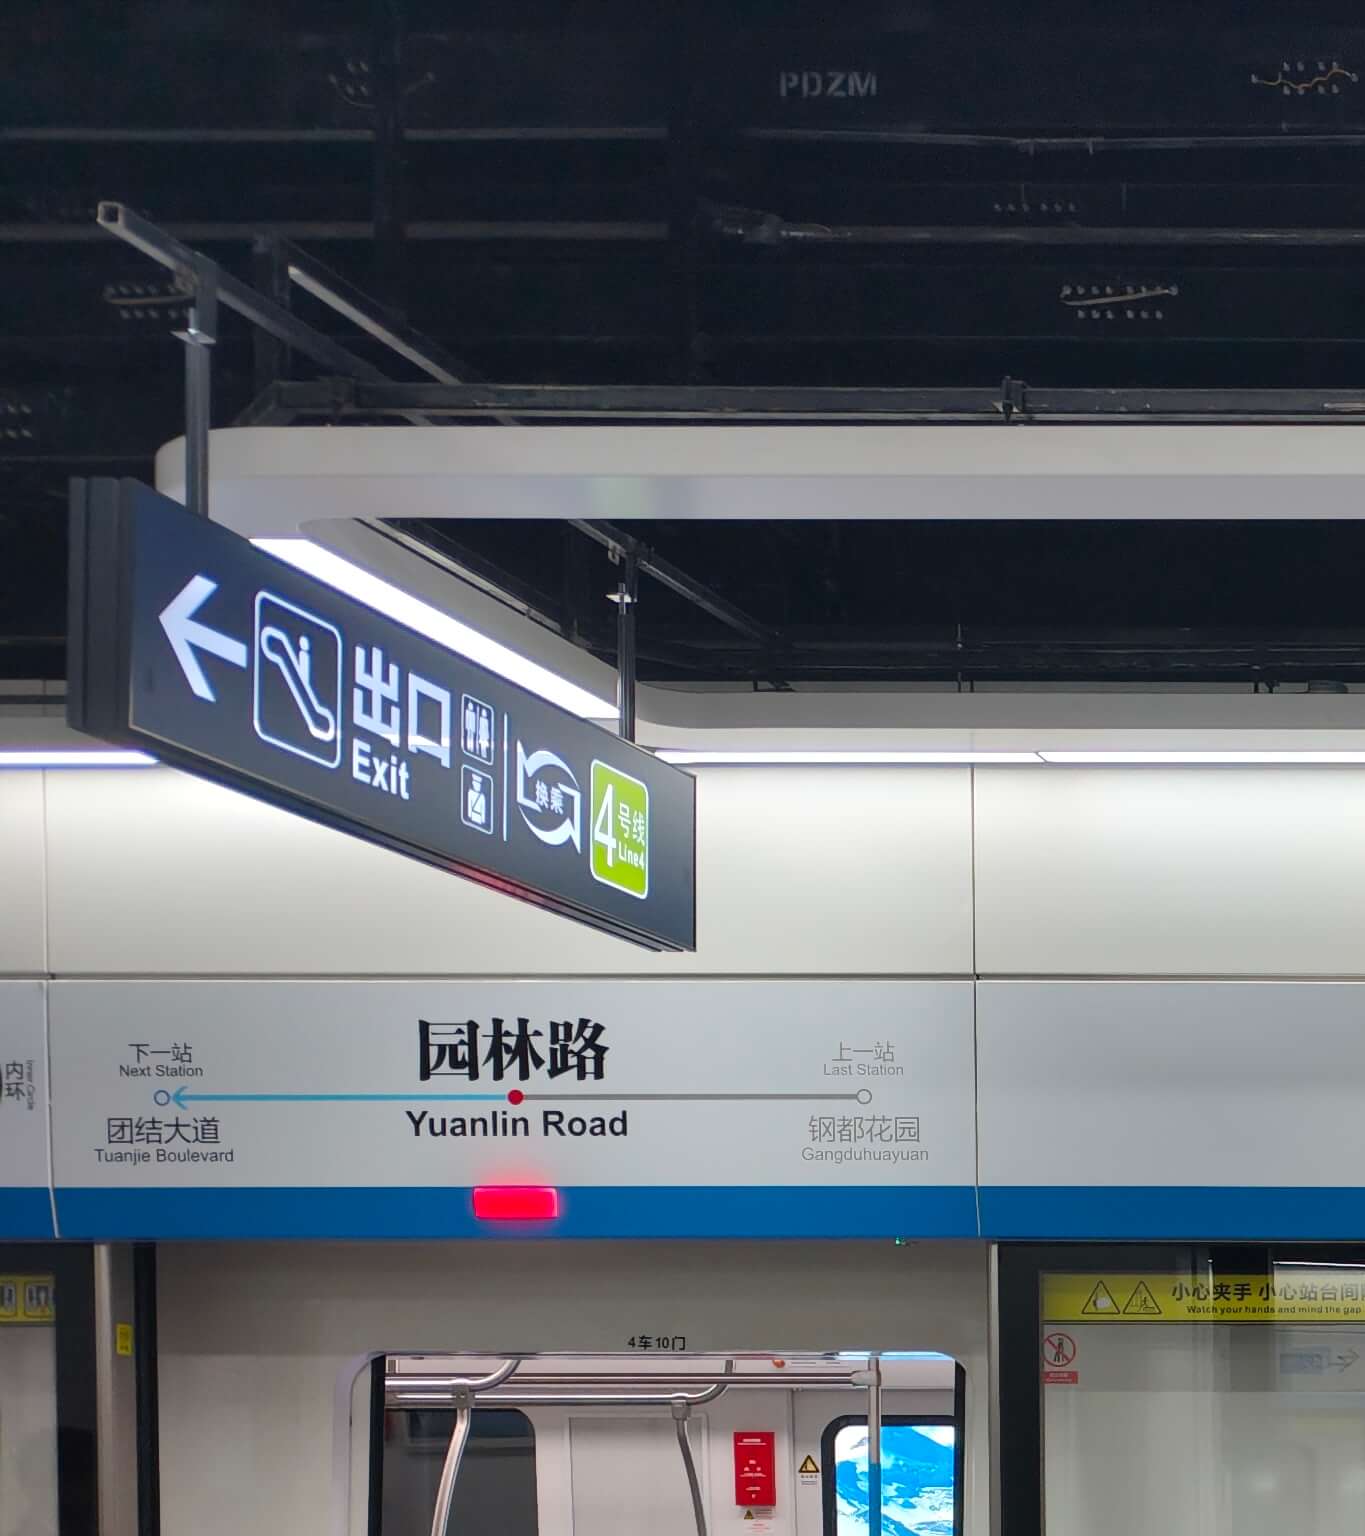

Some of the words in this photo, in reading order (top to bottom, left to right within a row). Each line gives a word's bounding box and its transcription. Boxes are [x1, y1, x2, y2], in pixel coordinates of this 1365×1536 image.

[780, 71, 877, 97] PDZM
[353, 645, 451, 768] 出口
[352, 743, 409, 800] Exit
[535, 779, 564, 815] 换乘
[128, 1043, 193, 1063] 下一站
[418, 1018, 610, 1081] 园林路
[832, 1040, 895, 1062] 上一站
[119, 1065, 151, 1077] Next
[155, 1064, 204, 1077] Station
[823, 1063, 853, 1076] Last
[857, 1063, 904, 1076] Station
[107, 1117, 221, 1144] 团结大道
[405, 1110, 530, 1137] Yuanlin
[543, 1109, 628, 1137] Road
[808, 1115, 920, 1143] 钢都花园
[94, 1149, 151, 1166] Tuanjie
[156, 1148, 234, 1163] Boulevard
[801, 1147, 929, 1164] Gangduhuayuan
[1172, 1283, 1252, 1301] 小心夹手
[627, 1334, 686, 1351] 4车10门
